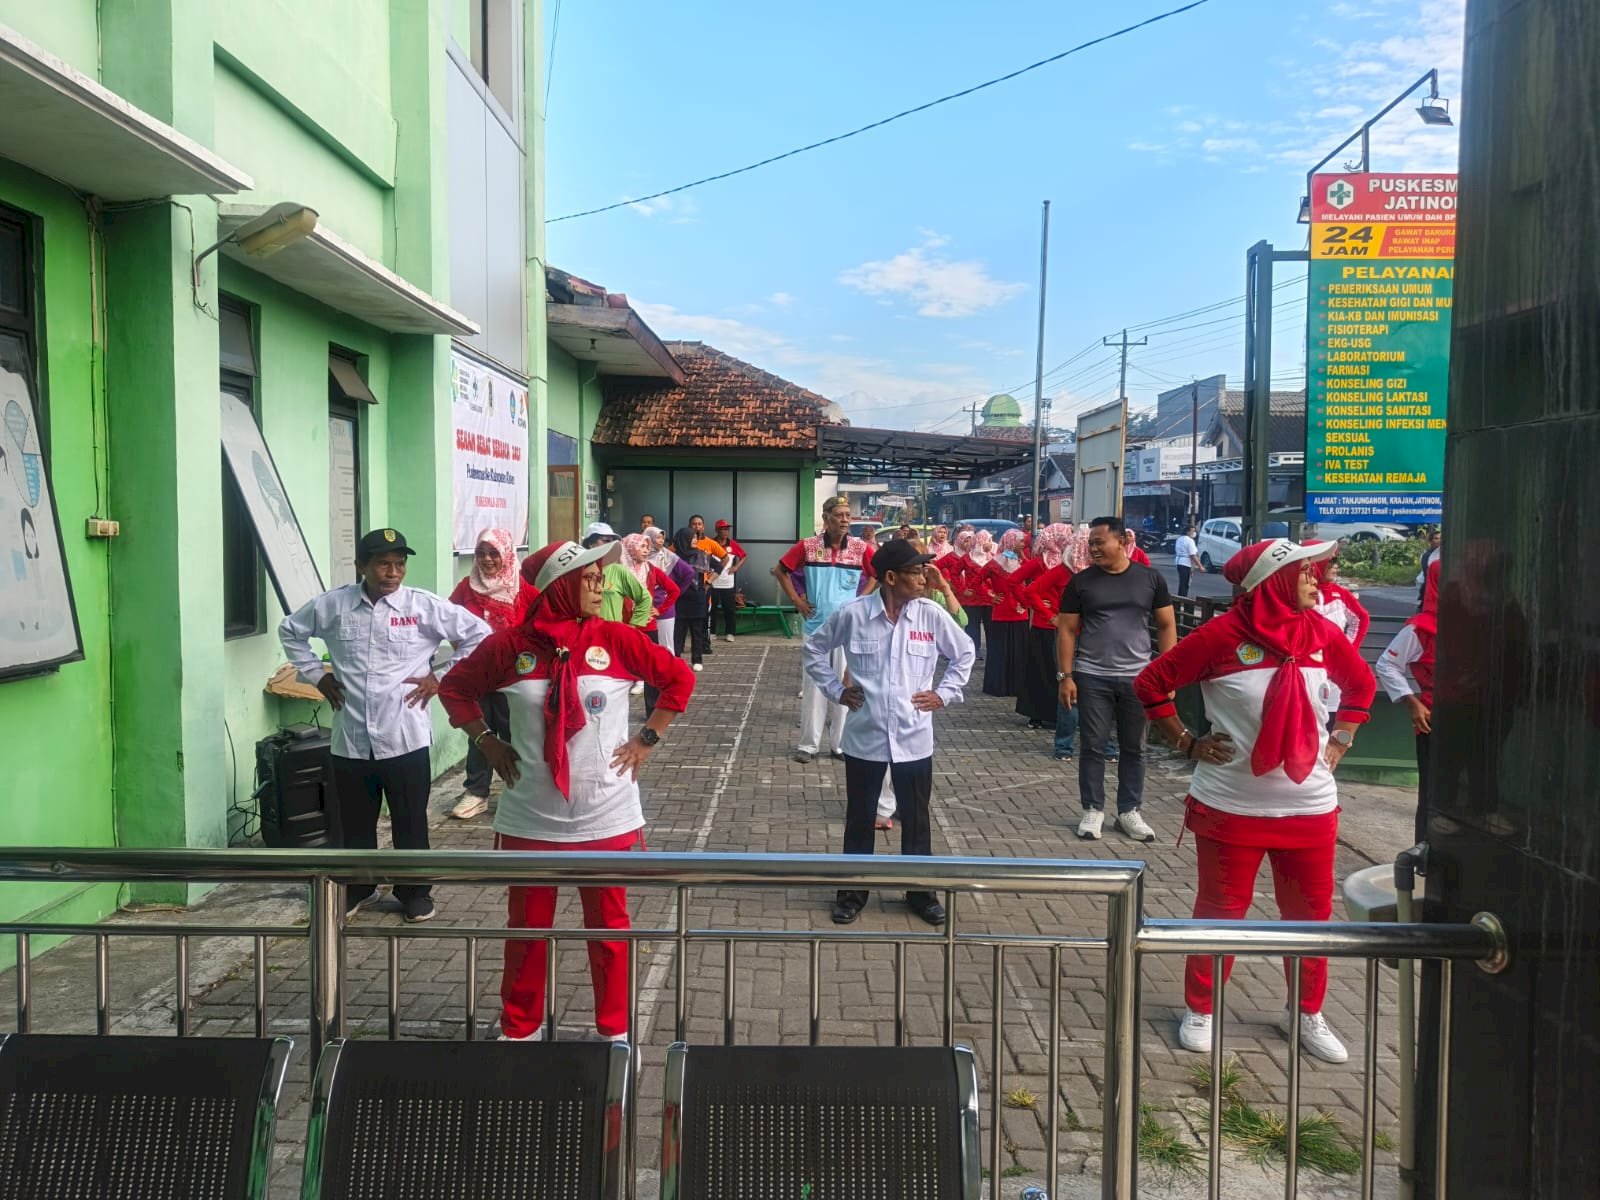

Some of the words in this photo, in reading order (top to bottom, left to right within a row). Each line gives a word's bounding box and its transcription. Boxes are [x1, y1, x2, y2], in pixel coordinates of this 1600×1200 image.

[1321, 213, 1363, 221] MELAYANI
[1365, 213, 1395, 221] PASIEN
[1397, 213, 1423, 221] UMUM
[1425, 213, 1442, 221] DAN
[1322, 226, 1374, 244] 24
[1392, 237, 1420, 245] RAWAT
[1422, 237, 1441, 245] INAP
[1321, 246, 1369, 256] JAM
[1388, 246, 1434, 254] PELAYANAN
[1328, 283, 1399, 294] PEMERIKSAAN
[1402, 283, 1432, 294] UMUM
[1328, 297, 1387, 308] KESEHATAN
[1390, 297, 1410, 308] GIGI
[1413, 297, 1433, 308] DAN
[1328, 311, 1362, 321] KIA-KB
[1365, 311, 1385, 321] DAN
[1388, 311, 1439, 321] IMUNISASI
[1328, 325, 1389, 335] FISIOTERAPI
[1328, 338, 1371, 348] EKG-USG
[1327, 351, 1405, 362] LABORATORIUM
[1327, 365, 1370, 375] FARMASI
[1326, 378, 1384, 389] KONSELING
[1386, 378, 1407, 389] GIZI
[1326, 391, 1384, 402] KONSELING
[1386, 391, 1428, 402] LAKTASI
[1326, 405, 1383, 416] KONSELING
[1386, 405, 1431, 416] SANITASI
[1326, 418, 1383, 429] KONSELING
[1386, 418, 1425, 429] INFEKSI
[1325, 432, 1371, 443] SEKSUAL
[1325, 446, 1375, 456] PROLANIS
[1325, 459, 1341, 469] IVA
[1344, 459, 1369, 469] TEST
[1325, 473, 1384, 483] KESEHATAN
[1386, 473, 1427, 483] REMAJA
[1314, 496, 1338, 505] ALAMAT
